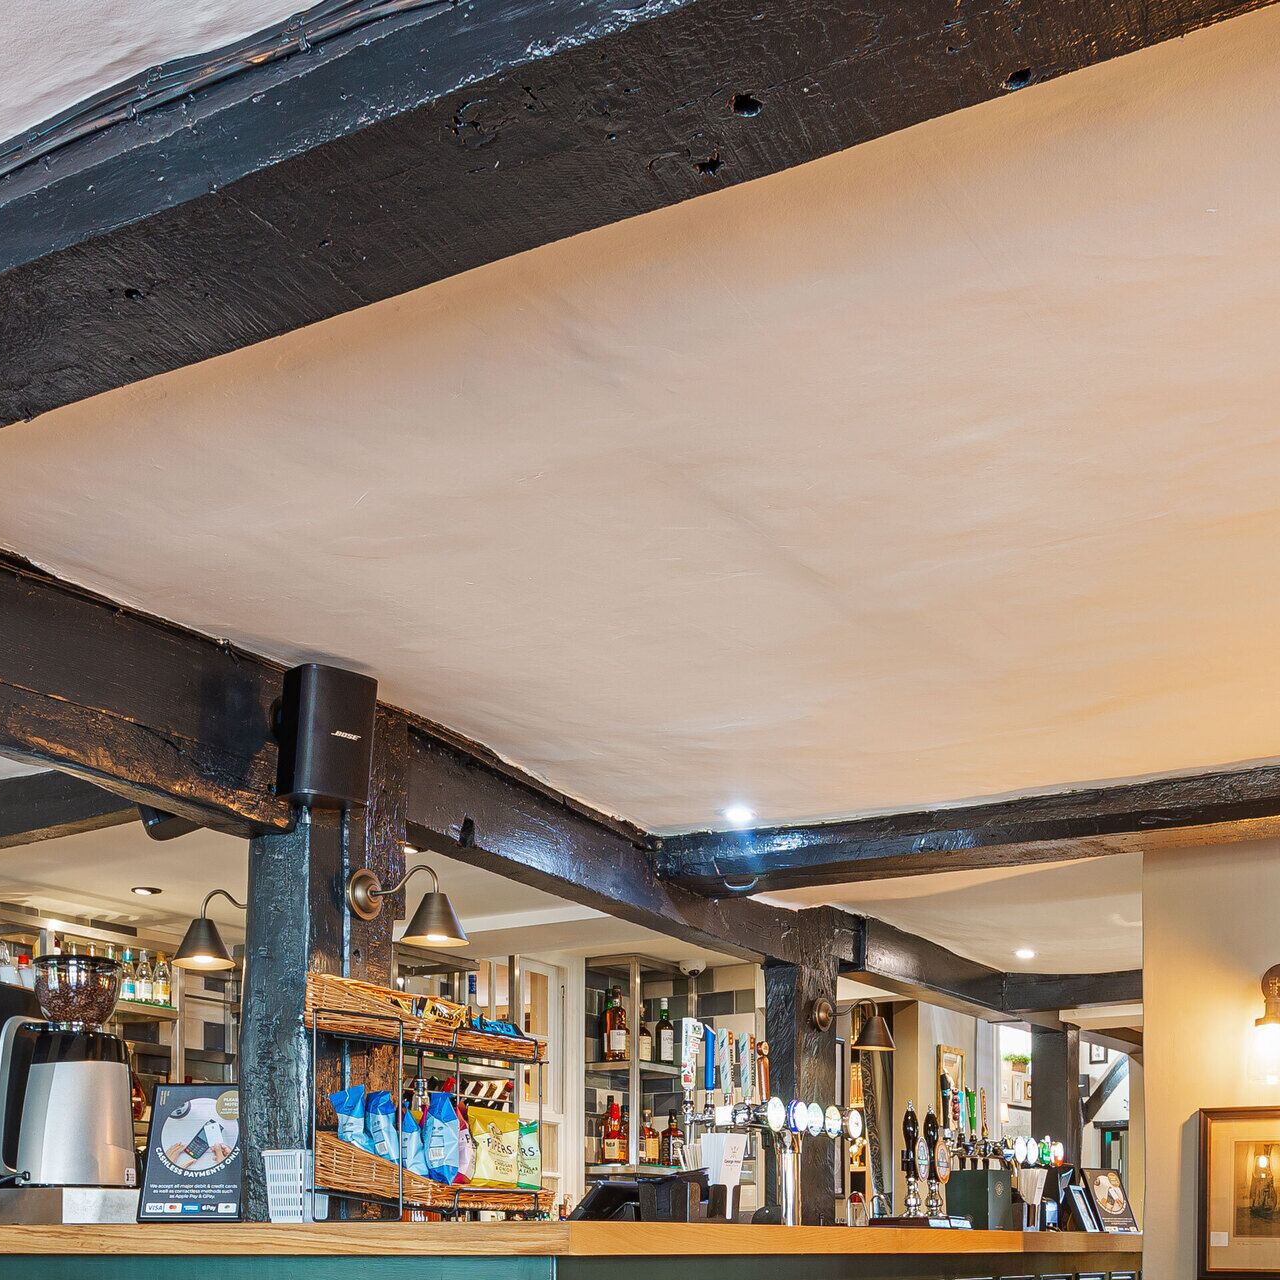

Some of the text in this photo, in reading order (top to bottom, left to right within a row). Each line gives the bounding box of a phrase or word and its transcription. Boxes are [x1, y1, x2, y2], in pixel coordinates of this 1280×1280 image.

[155, 1146, 240, 1178] CASHLESS PAYMENTS ONLY
